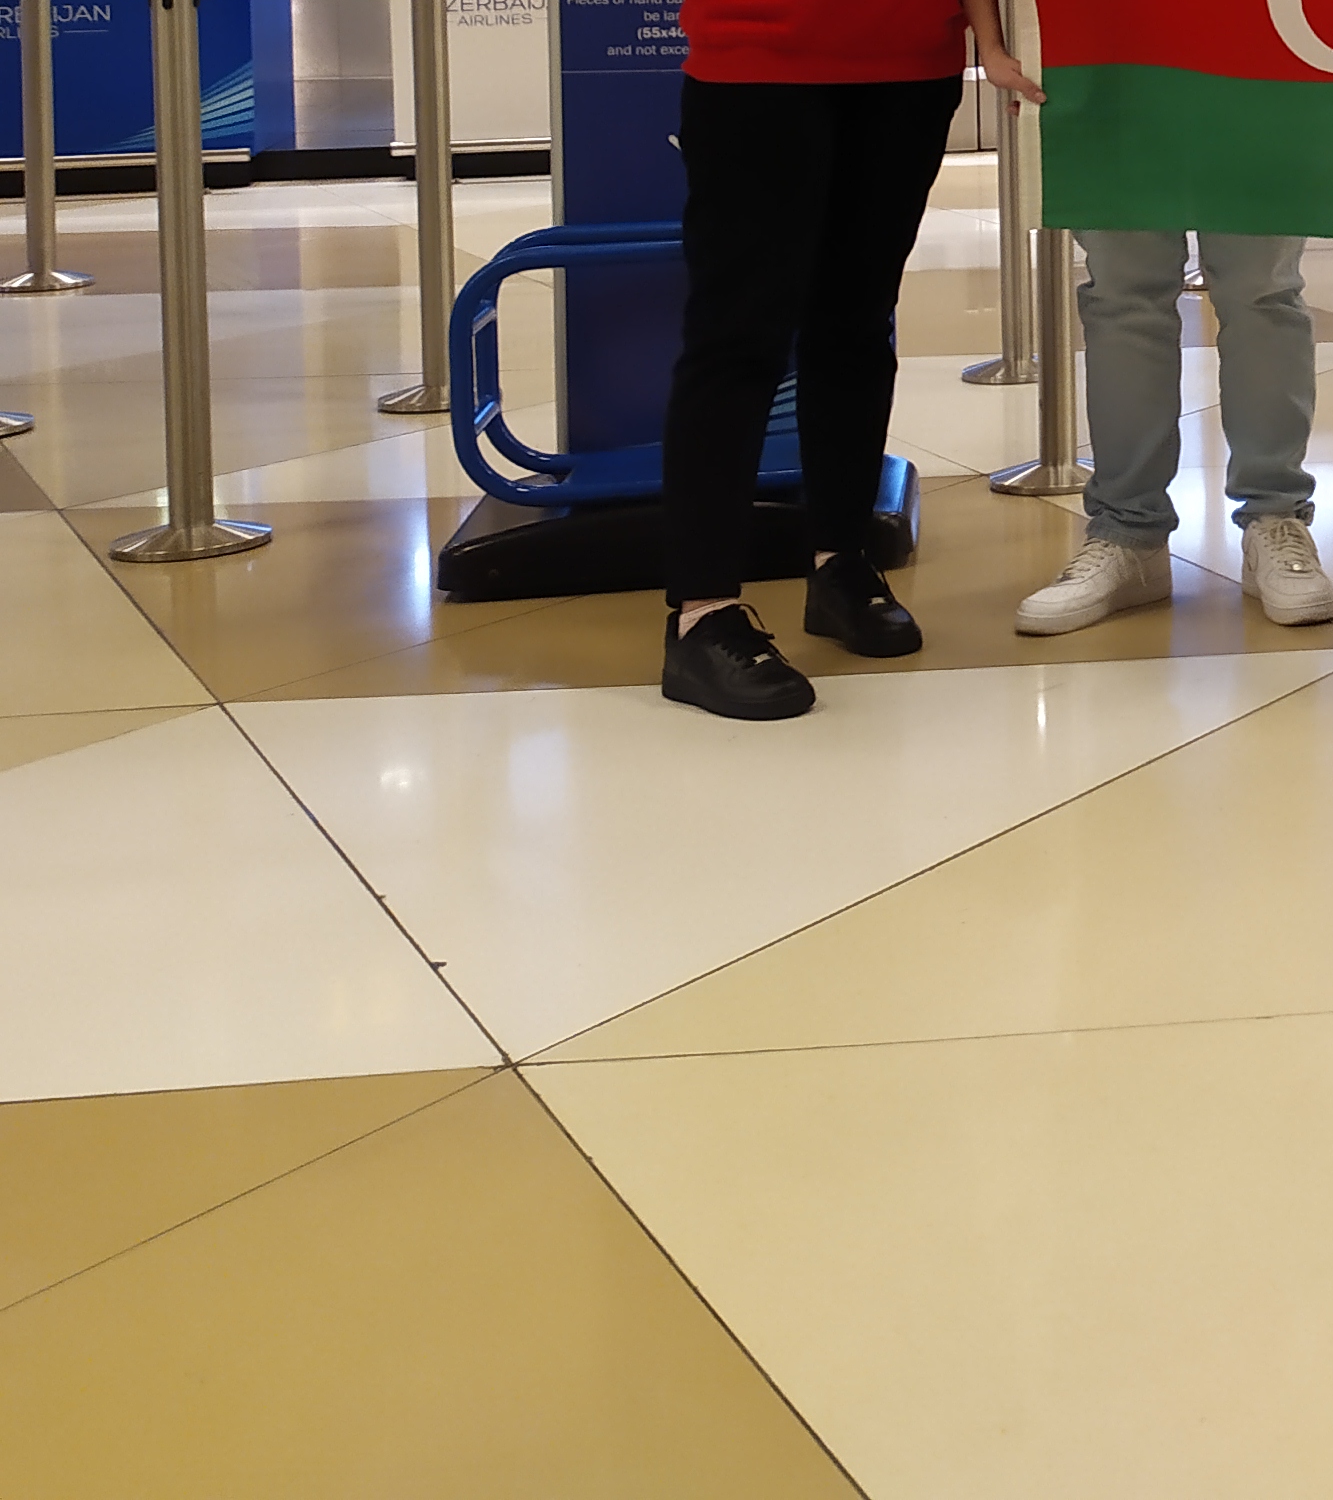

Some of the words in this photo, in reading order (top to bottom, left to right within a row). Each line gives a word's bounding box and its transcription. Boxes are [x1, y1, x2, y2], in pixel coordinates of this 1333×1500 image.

[457, 12, 533, 27] AIRLINES
[643, 10, 660, 22] be
[607, 45, 632, 56] and
[636, 45, 657, 56] not
